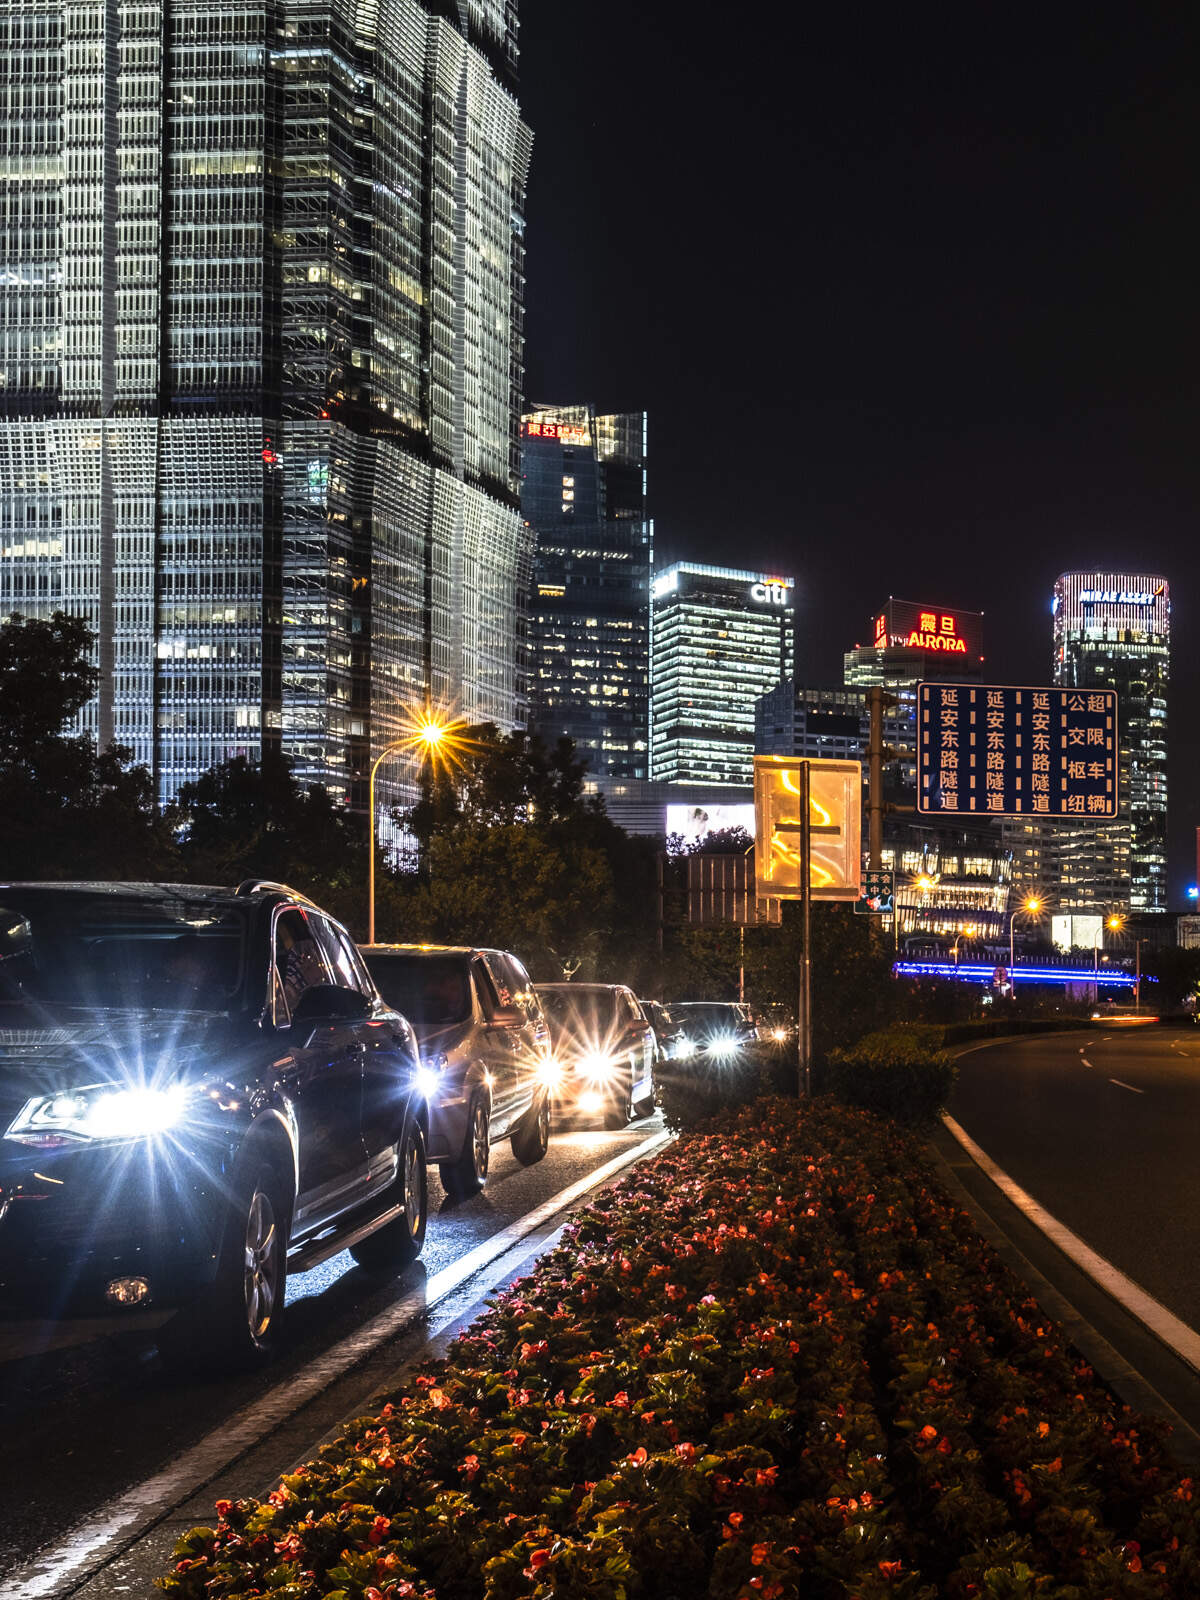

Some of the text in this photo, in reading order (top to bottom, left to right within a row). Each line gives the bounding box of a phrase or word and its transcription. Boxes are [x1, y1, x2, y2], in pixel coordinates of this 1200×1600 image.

[909, 631, 967, 653] AURORA
[920, 613, 956, 636] 震旦
[940, 688, 960, 811] 延安东路隧道
[986, 690, 1005, 811] 延安东路隧道
[1031, 692, 1051, 813] 延安东路隧道
